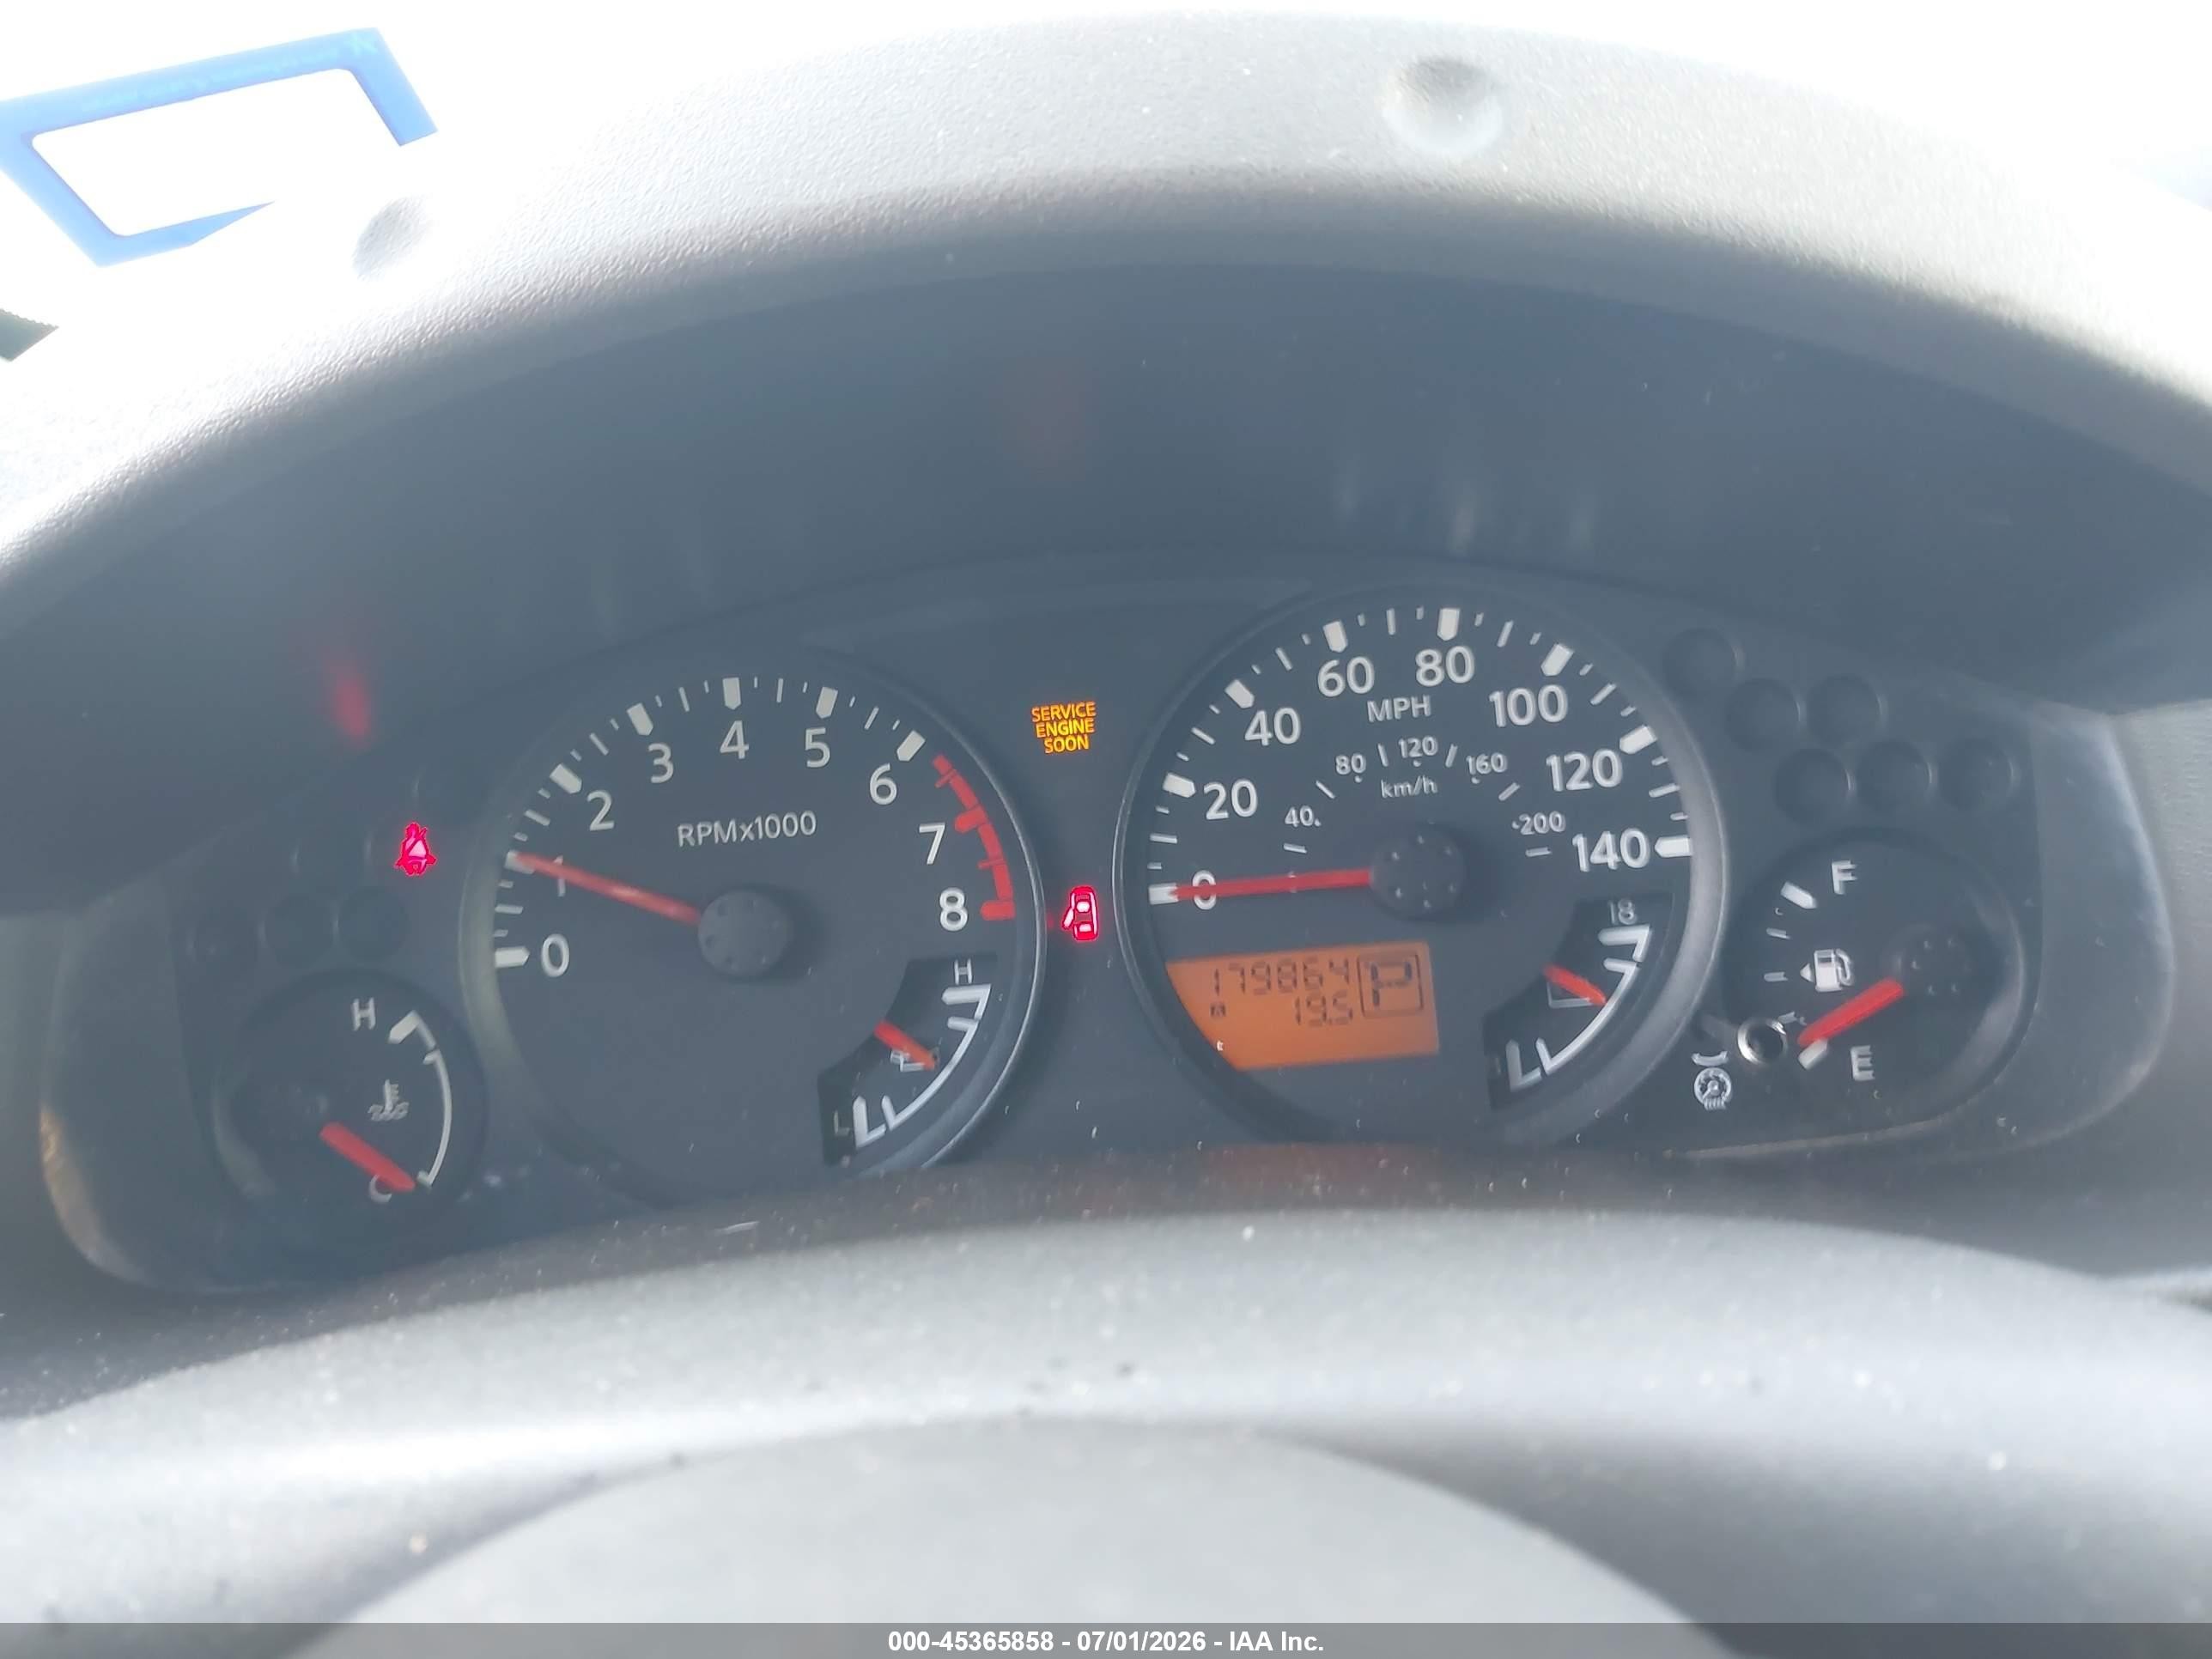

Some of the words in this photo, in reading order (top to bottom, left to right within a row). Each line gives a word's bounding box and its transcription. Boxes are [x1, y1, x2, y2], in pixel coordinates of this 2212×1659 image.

[1317, 656, 1374, 697] 60
[1414, 646, 1474, 686] 80
[1031, 701, 1097, 722] SERVICE
[1367, 695, 1431, 722] MPH
[1489, 684, 1568, 727] 100
[720, 721, 749, 759] 4
[1036, 717, 1095, 738] ENGINE
[1044, 734, 1089, 754] SOON
[1244, 707, 1301, 745] 40
[648, 744, 674, 783] 3
[804, 727, 830, 768] 5
[1336, 753, 1366, 775] 80
[1398, 736, 1438, 759] 120
[1467, 752, 1507, 775] 160
[868, 764, 898, 805] 6
[1381, 775, 1437, 799] km/h
[1546, 750, 1623, 792] 120
[587, 790, 615, 831] 2
[1204, 780, 1257, 820] 20
[1285, 806, 1315, 826] 40
[678, 811, 817, 848] RPMx1000
[1519, 811, 1566, 836] 200
[919, 823, 945, 865] 7
[1572, 828, 1650, 872] 140
[1832, 860, 1858, 895] F
[939, 888, 968, 931] 8
[1607, 899, 1638, 925] 18
[540, 933, 569, 977] 0
[953, 959, 972, 984] H
[1212, 956, 1349, 997] 179864
[1369, 958, 1413, 1007] P
[351, 998, 376, 1030] H
[1850, 1045, 1875, 1081] E
